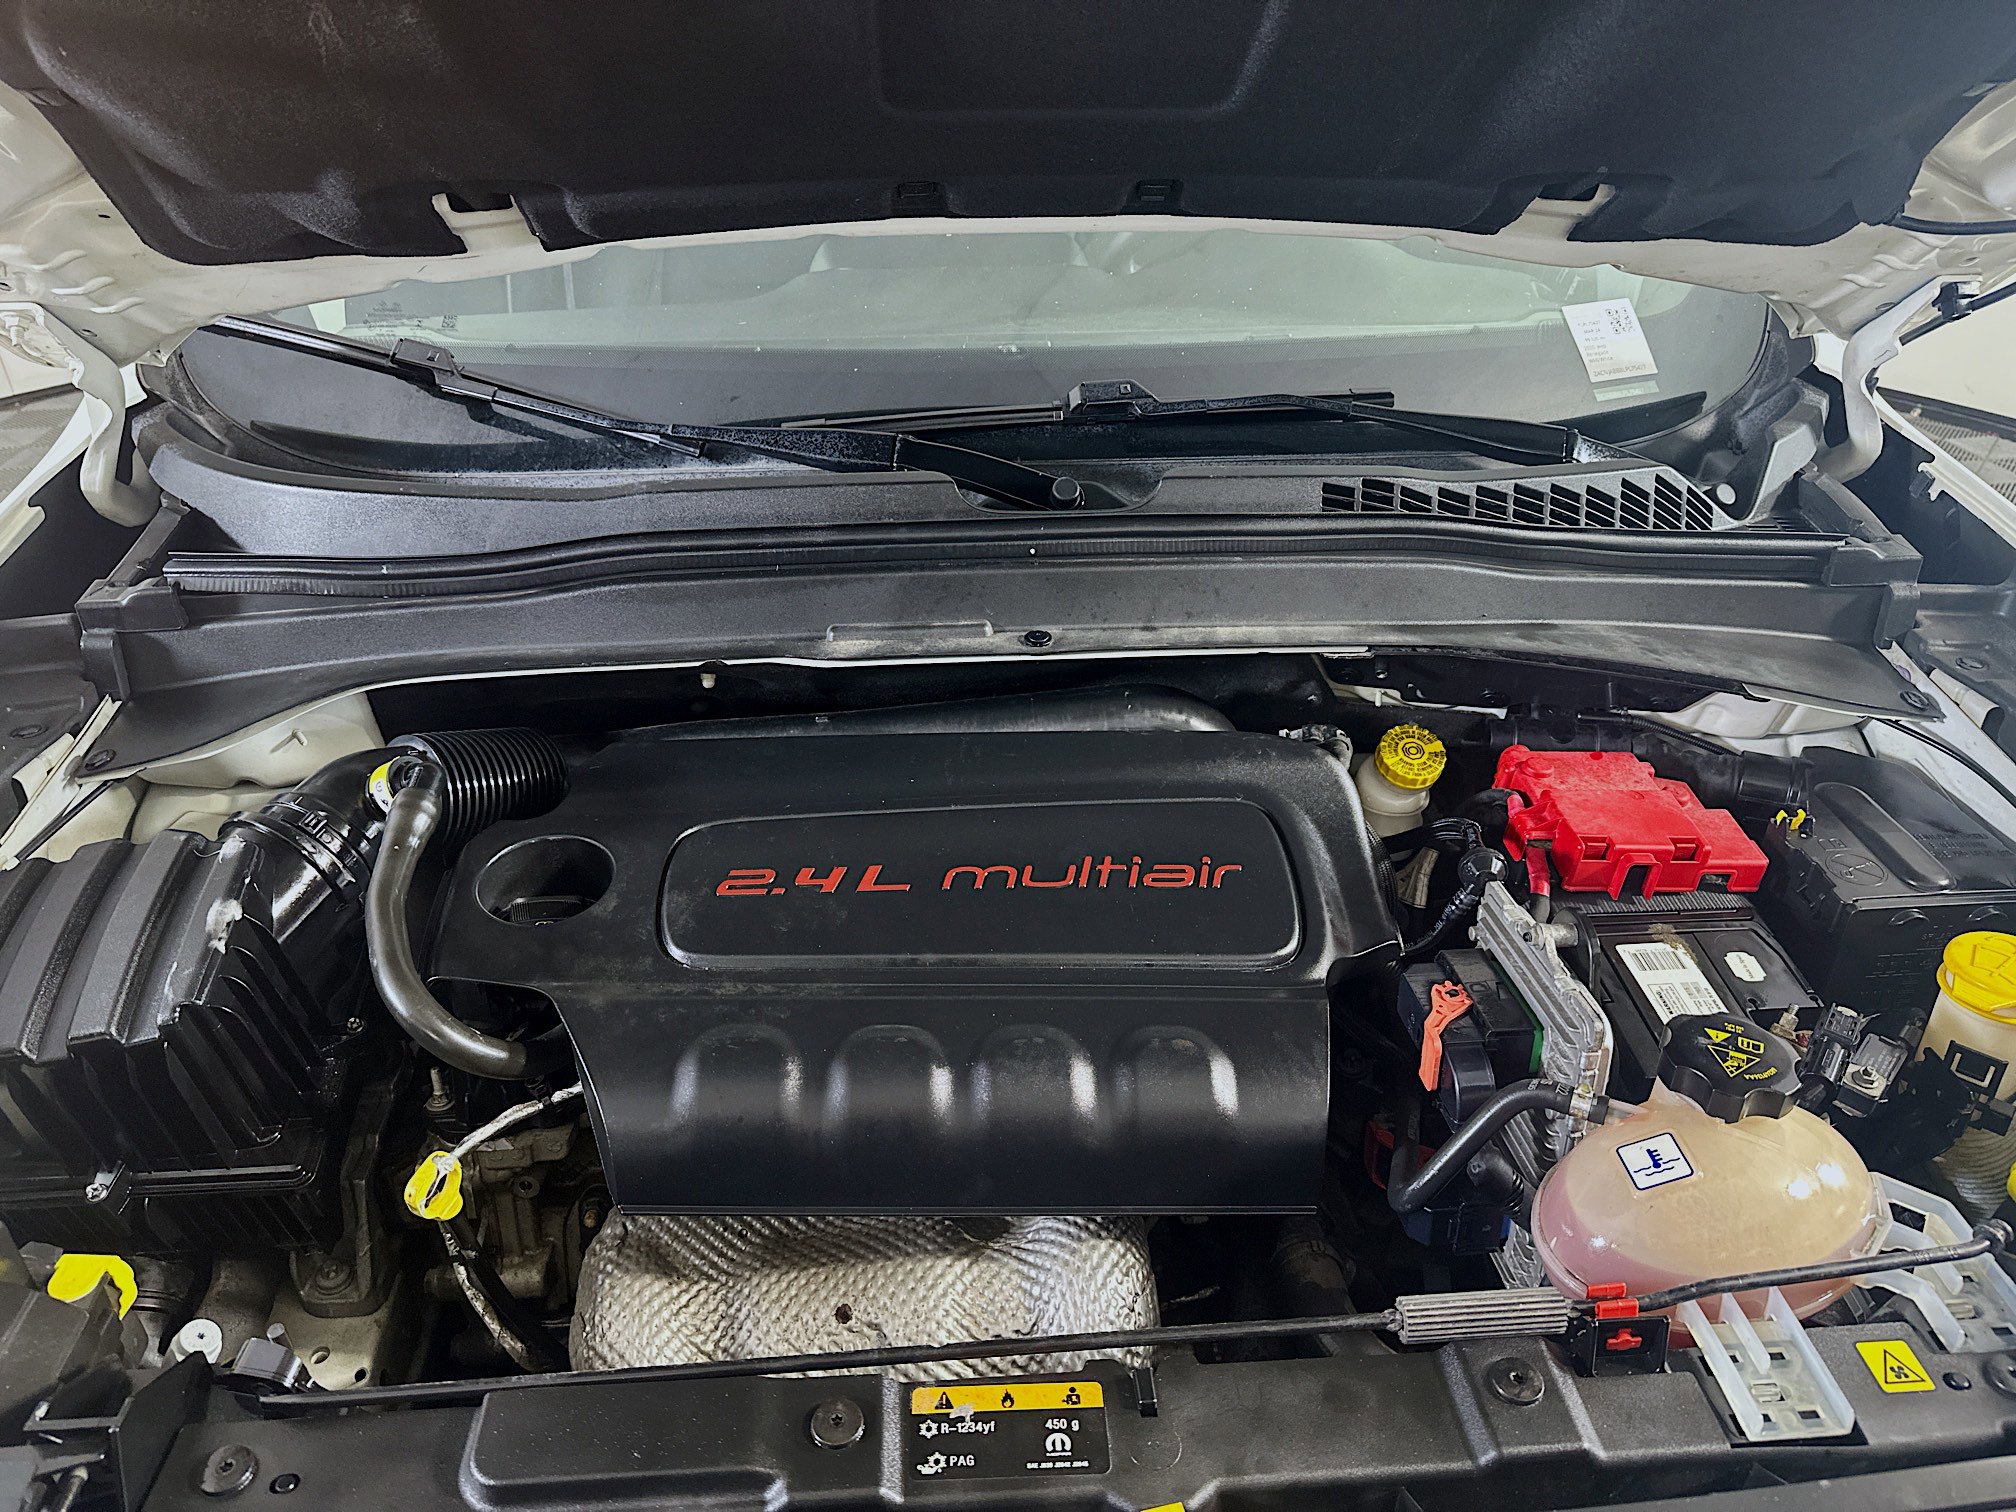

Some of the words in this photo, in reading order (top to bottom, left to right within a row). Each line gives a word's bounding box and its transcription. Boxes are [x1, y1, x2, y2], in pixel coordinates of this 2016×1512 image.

[942, 855, 1241, 889] multiair
[940, 1420, 996, 1435] R-1234yf
[1045, 1418, 1068, 1430] 450
[1071, 1419, 1080, 1432] g
[949, 1454, 976, 1467] PAG
